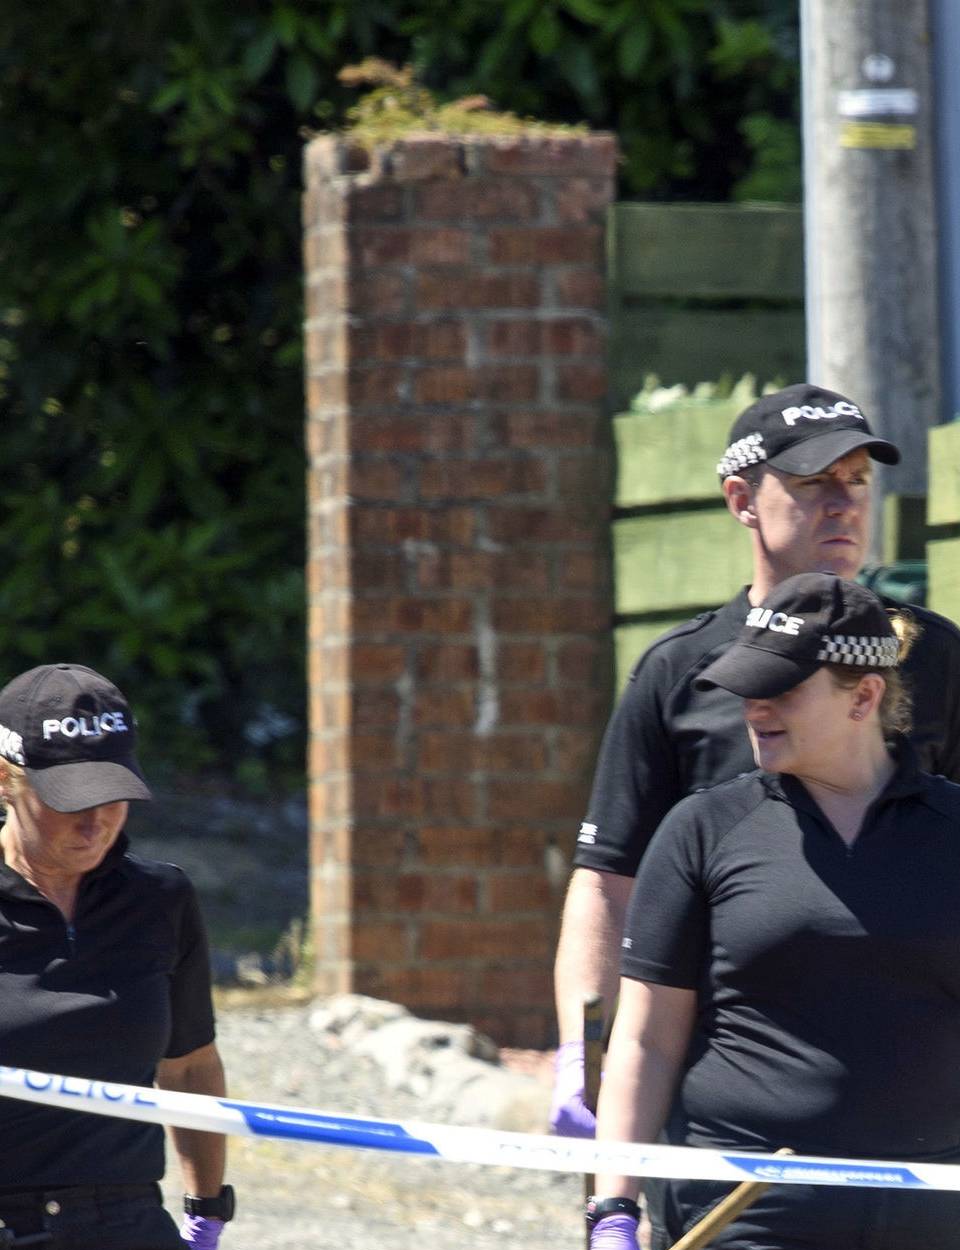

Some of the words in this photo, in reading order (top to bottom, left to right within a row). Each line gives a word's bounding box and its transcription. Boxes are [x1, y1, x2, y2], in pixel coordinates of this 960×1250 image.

[745, 607, 805, 636] LICE
[42, 711, 128, 741] POLICE
[0, 1064, 157, 1108] OLIC
